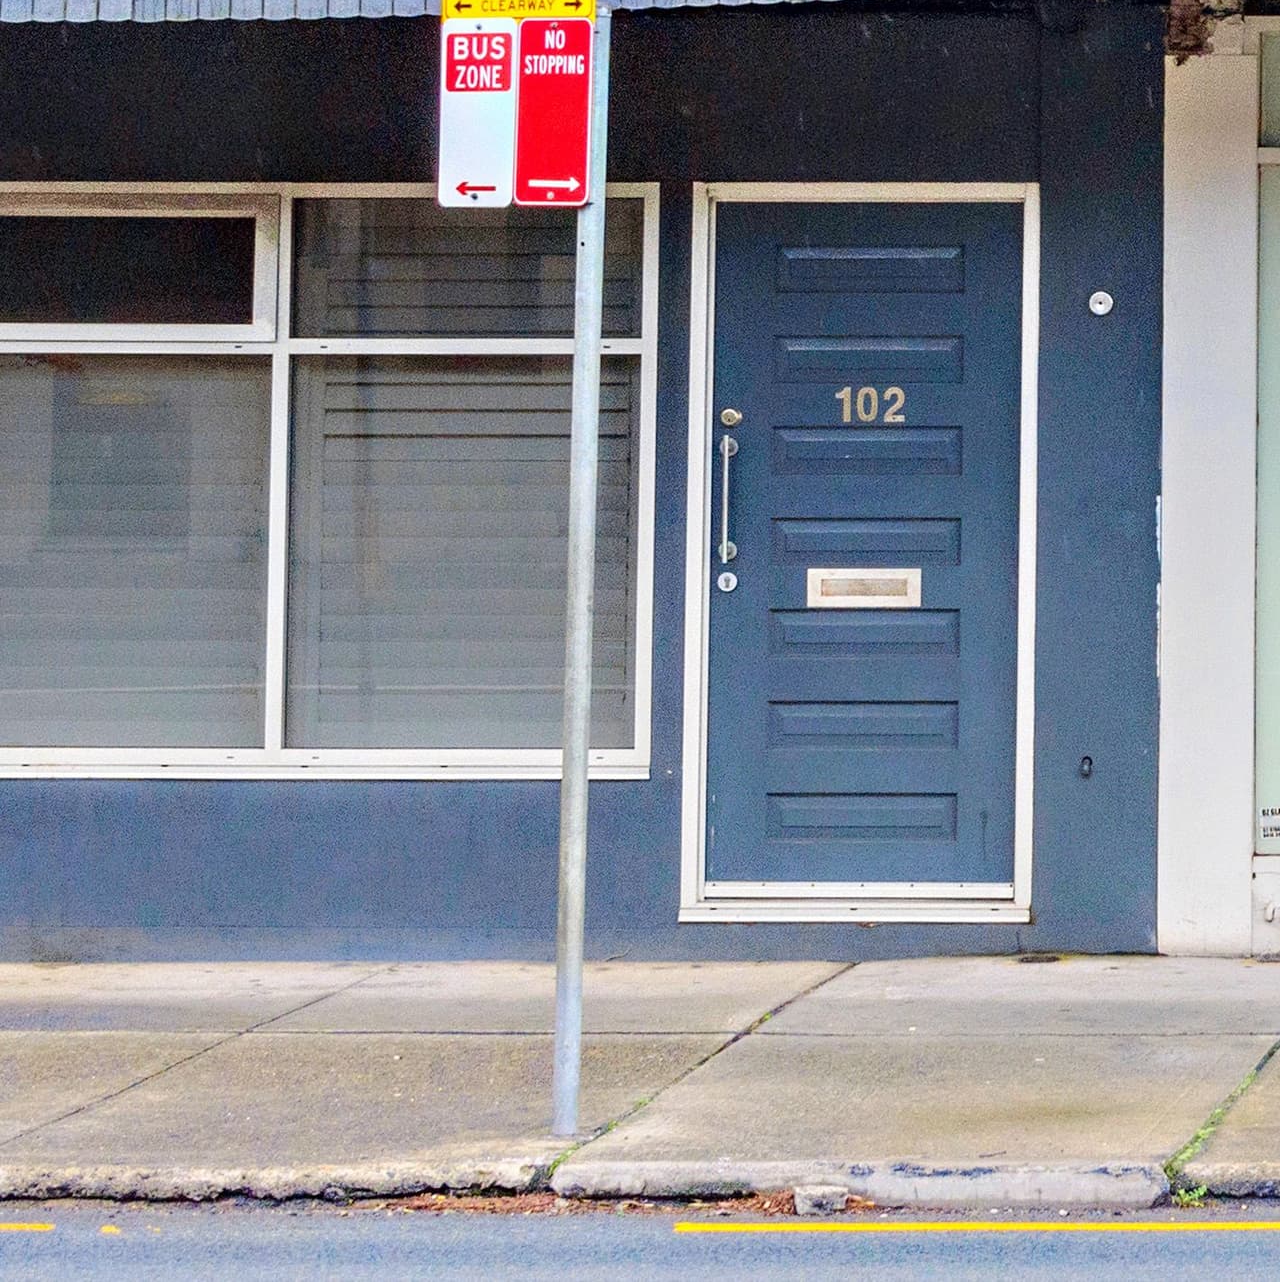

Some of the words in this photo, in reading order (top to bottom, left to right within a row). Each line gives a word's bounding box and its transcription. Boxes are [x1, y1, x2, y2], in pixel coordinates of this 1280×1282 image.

[453, 36, 506, 60] BUS
[544, 29, 566, 49] NO
[455, 64, 502, 89] ZONE
[524, 54, 585, 75] STOPPING
[835, 386, 906, 422] 102
